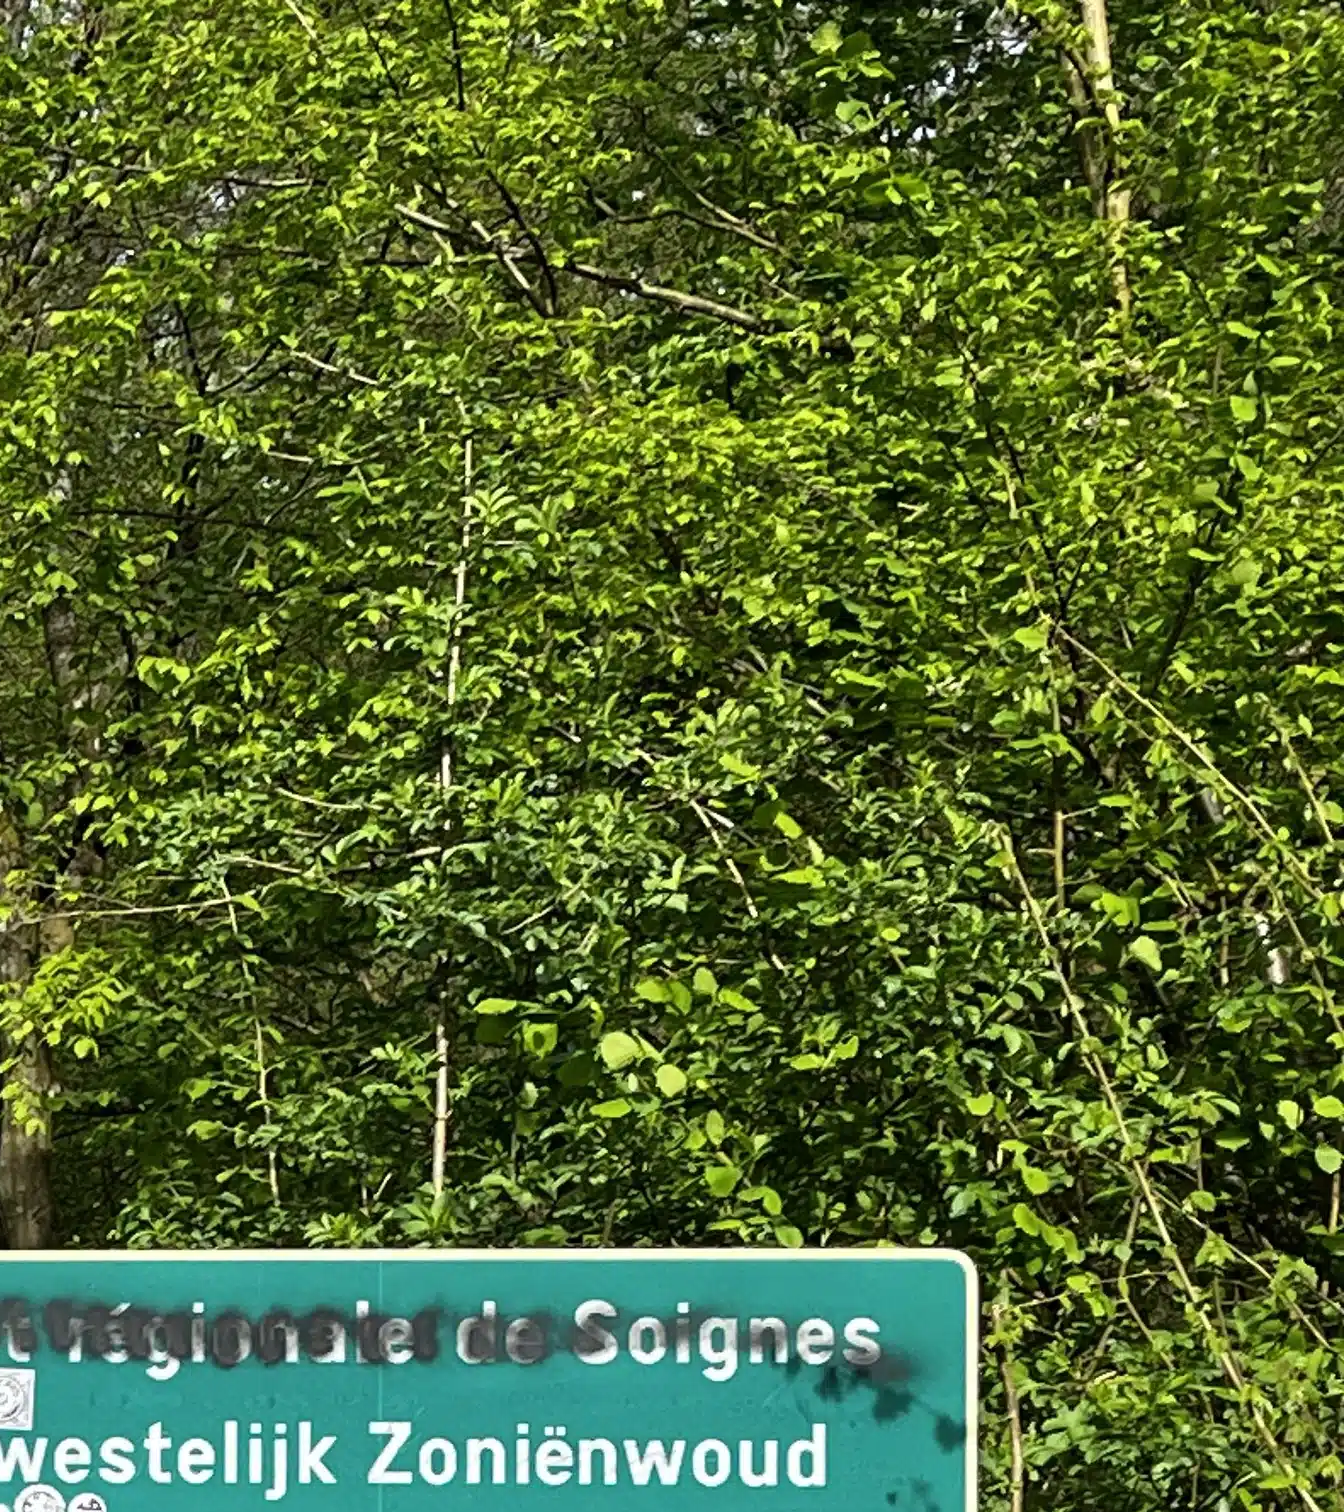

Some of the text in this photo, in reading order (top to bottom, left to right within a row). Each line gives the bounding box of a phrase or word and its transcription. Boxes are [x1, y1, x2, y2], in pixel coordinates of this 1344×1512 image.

[455, 1300, 546, 1365] de
[574, 1299, 882, 1381] Soignes
[367, 1420, 827, 1487] Zoniënwoud
